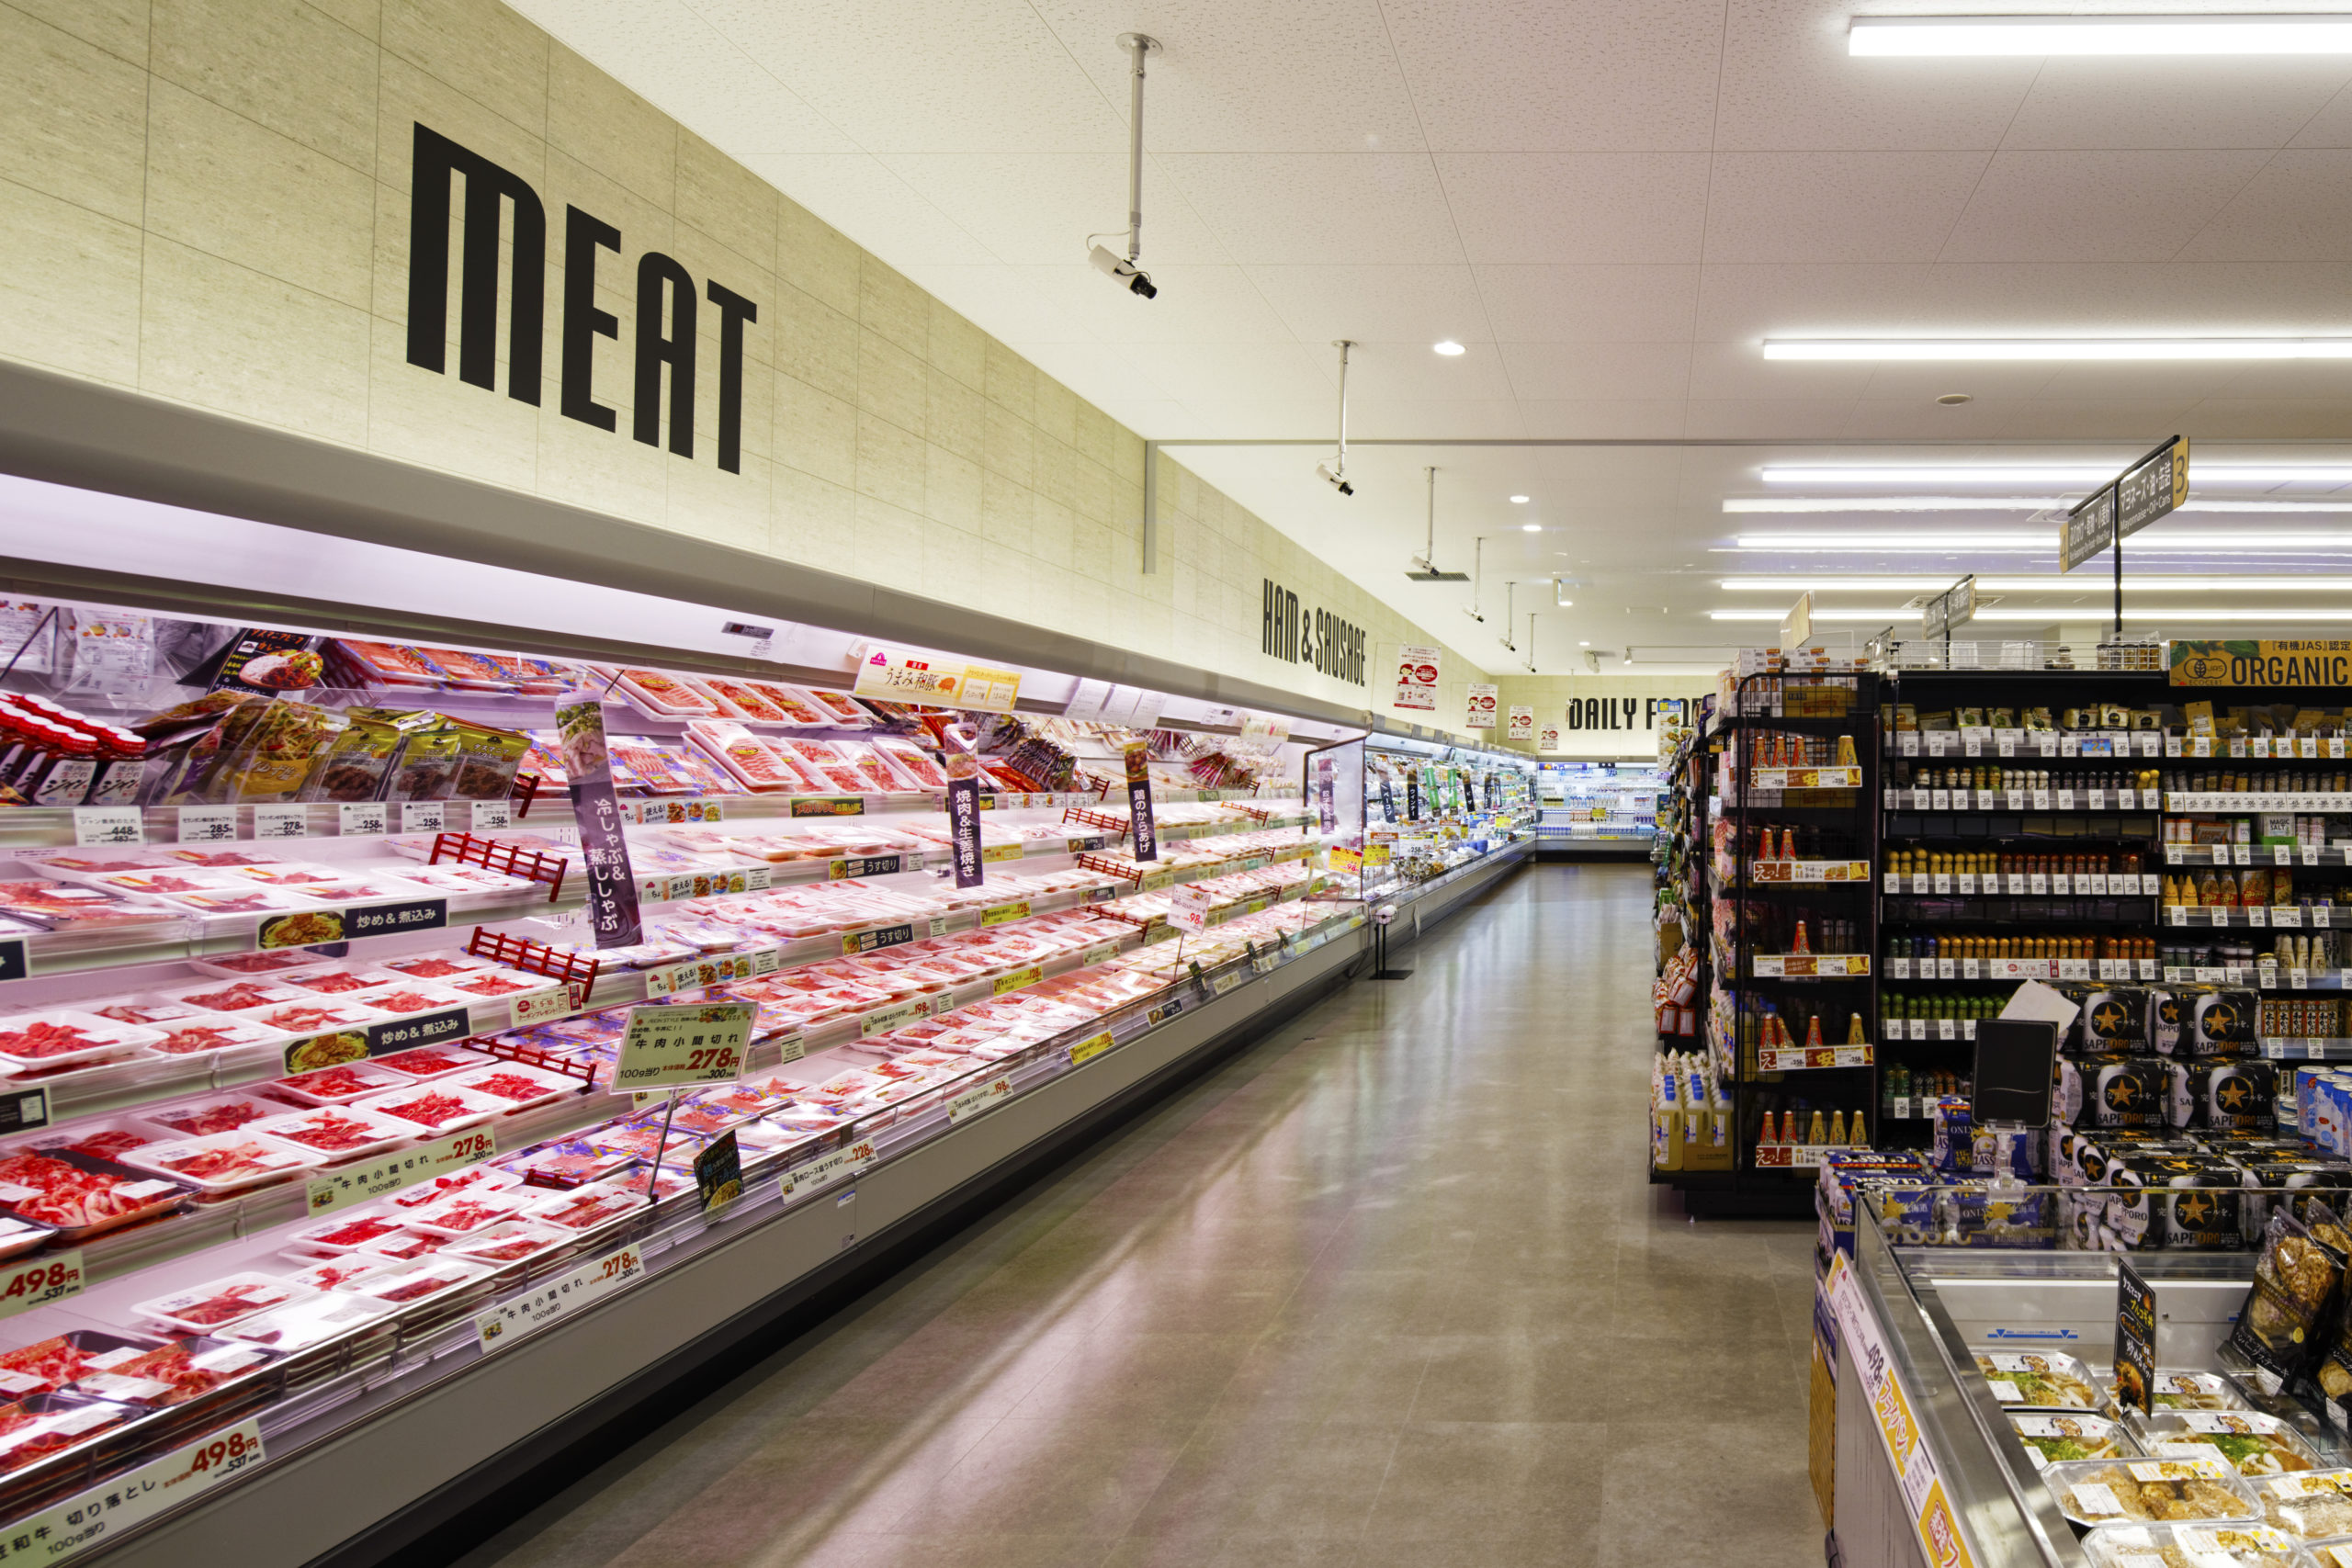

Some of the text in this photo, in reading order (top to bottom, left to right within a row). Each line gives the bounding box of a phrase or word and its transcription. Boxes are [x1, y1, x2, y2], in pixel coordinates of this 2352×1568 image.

[406, 120, 757, 475] MEAT
[2175, 455, 2185, 494] 3
[1262, 578, 1366, 687] HAM & SAUSAGE
[884, 668, 940, 692] うまみ和豚
[2231, 656, 2348, 685] ORGANIC
[1569, 697, 1637, 730] DAILY
[2269, 818, 2290, 826] MAGIC
[594, 798, 627, 881] 冷しゃぶ&
[867, 859, 897, 873] うす切り
[588, 848, 618, 931] 蒸ししゃぶ
[356, 908, 436, 929] 炒め&煮込み
[879, 928, 909, 943] うす切り
[381, 1019, 458, 1045] 炒め&煮込み
[635, 1033, 739, 1050] 牛肉小間切れ
[2084, 1039, 2130, 1050] SAPPORO
[2195, 1041, 2239, 1052] SAPPORO
[685, 1047, 741, 1071] 278円
[619, 1066, 661, 1079] 100g当り
[1951, 1125, 1974, 1134] ONLY
[2098, 1113, 2144, 1124] SAPPORO
[2210, 1114, 2256, 1127] SAPPORO
[452, 1134, 492, 1159] 278円
[341, 1155, 429, 1190] 牛肉小間切れ
[368, 1177, 401, 1194] 100g当り
[1962, 1207, 1987, 1218] ONLY
[2167, 1233, 2220, 1245] SAPPORO
[603, 1252, 639, 1279] 278円
[507, 1279, 582, 1320] 牛肉小間切れ
[531, 1303, 561, 1323] 100g当り
[191, 1432, 259, 1473] 498円
[67, 1479, 156, 1527] 切り落とし
[47, 1521, 106, 1555] 100g当り
